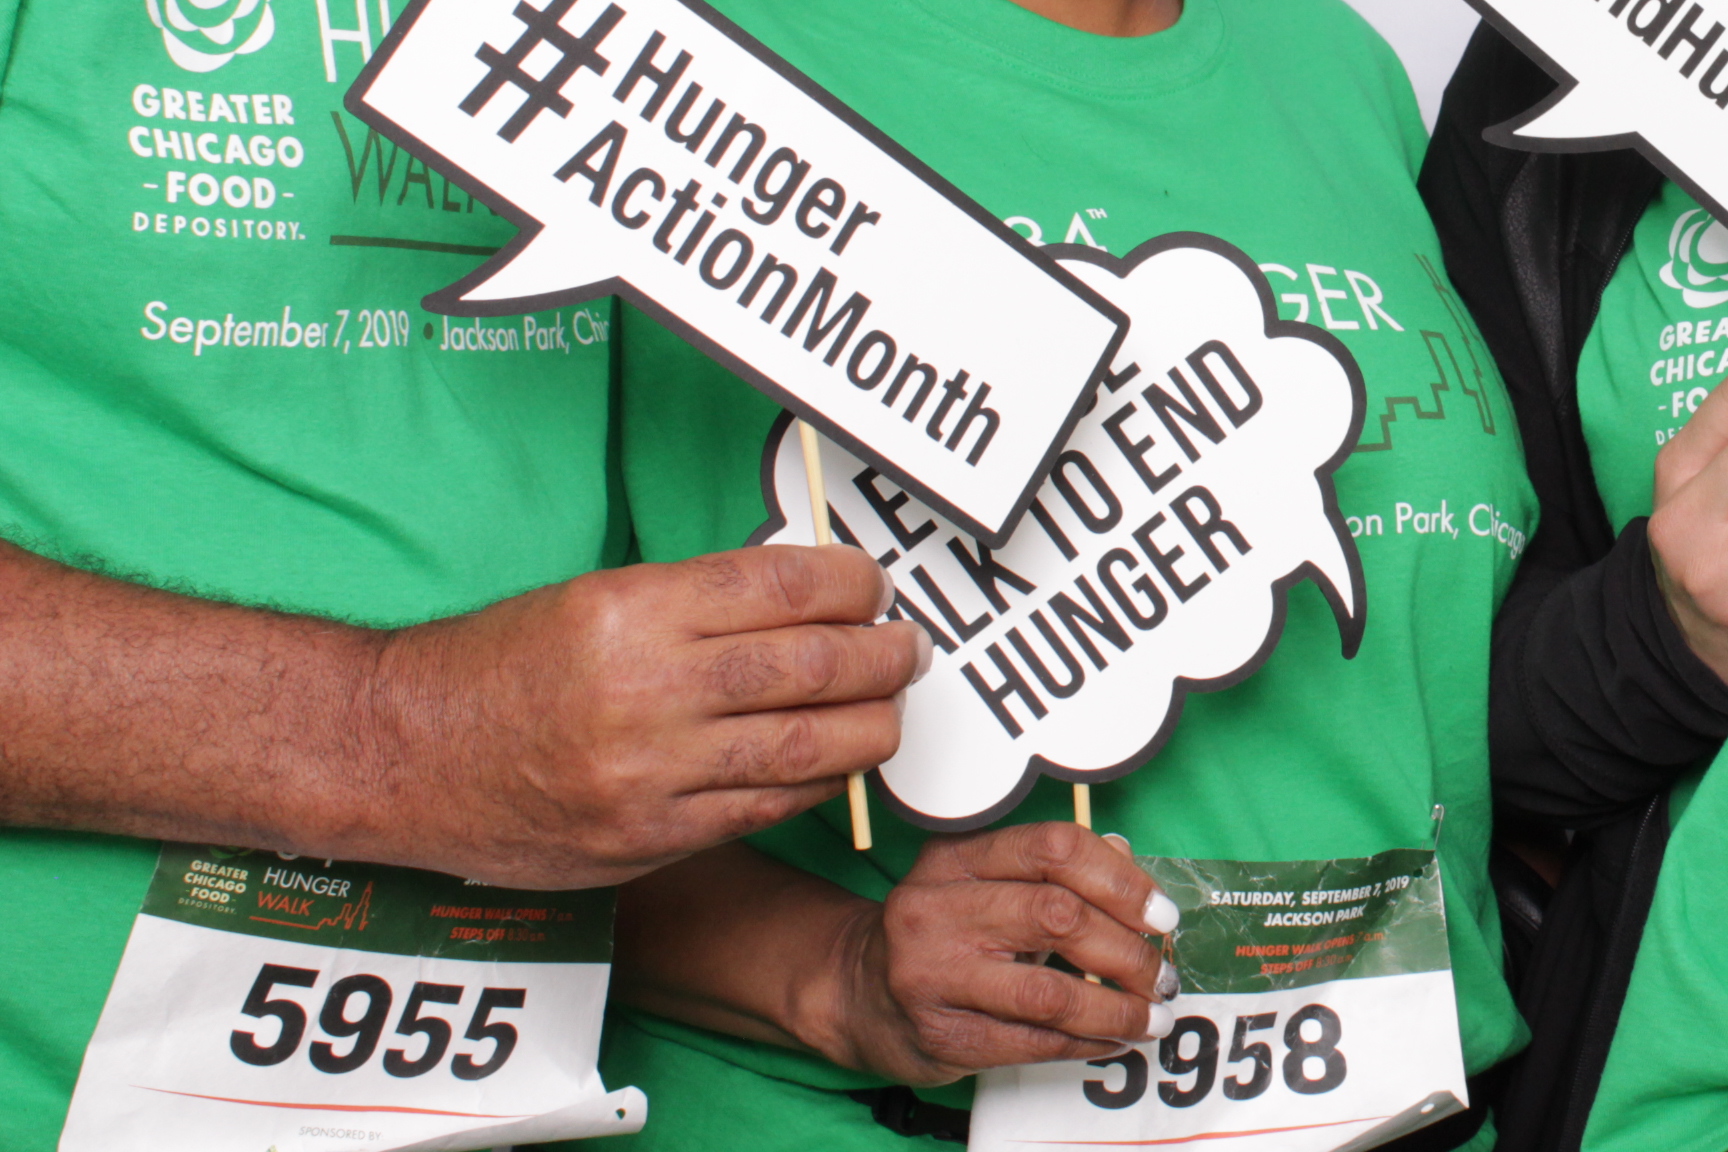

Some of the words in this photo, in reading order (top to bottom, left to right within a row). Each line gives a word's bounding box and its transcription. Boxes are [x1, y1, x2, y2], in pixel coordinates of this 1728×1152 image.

[132, 84, 295, 125] GREATER
[128, 126, 304, 168] CHICAGO
[330, 111, 498, 216] WAL
[552, 119, 1000, 468] ActionMonth
[140, 300, 329, 356] September
[334, 309, 350, 354] 7,
[357, 309, 410, 348] 2019
[440, 315, 519, 351] Jackson
[524, 312, 570, 355] Park,
[883, 535, 1038, 655] ALK
[1101, 339, 1263, 495] END
[1395, 499, 1459, 540] Park,
[959, 484, 1254, 740] HUNGER
[184, 873, 247, 894] CHICAGO
[190, 860, 248, 881] GREATER
[263, 867, 351, 898] HUNGER
[257, 891, 315, 916] WALK
[1210, 890, 1296, 908] SATURDAY,
[1301, 885, 1373, 906] SEPTEMBER
[1373, 882, 1382, 898] 7,
[1384, 875, 1410, 894] 2019
[430, 905, 482, 920] HUNGER
[485, 908, 513, 920] WALK
[515, 908, 548, 921] OPENS
[1263, 910, 1335, 927] JACKSON
[1336, 904, 1367, 923] PARK
[450, 927, 485, 940] STEPS
[486, 928, 506, 941] OFF
[1235, 944, 1290, 957] HUNGER
[1292, 942, 1322, 955] WALK
[1324, 934, 1355, 949] OPENS
[1260, 962, 1294, 975] STEPS
[1295, 959, 1315, 972] OFF
[229, 962, 527, 1081] 5955
[1083, 1003, 1347, 1110] 5958
[299, 1126, 366, 1140] SPONSORED
